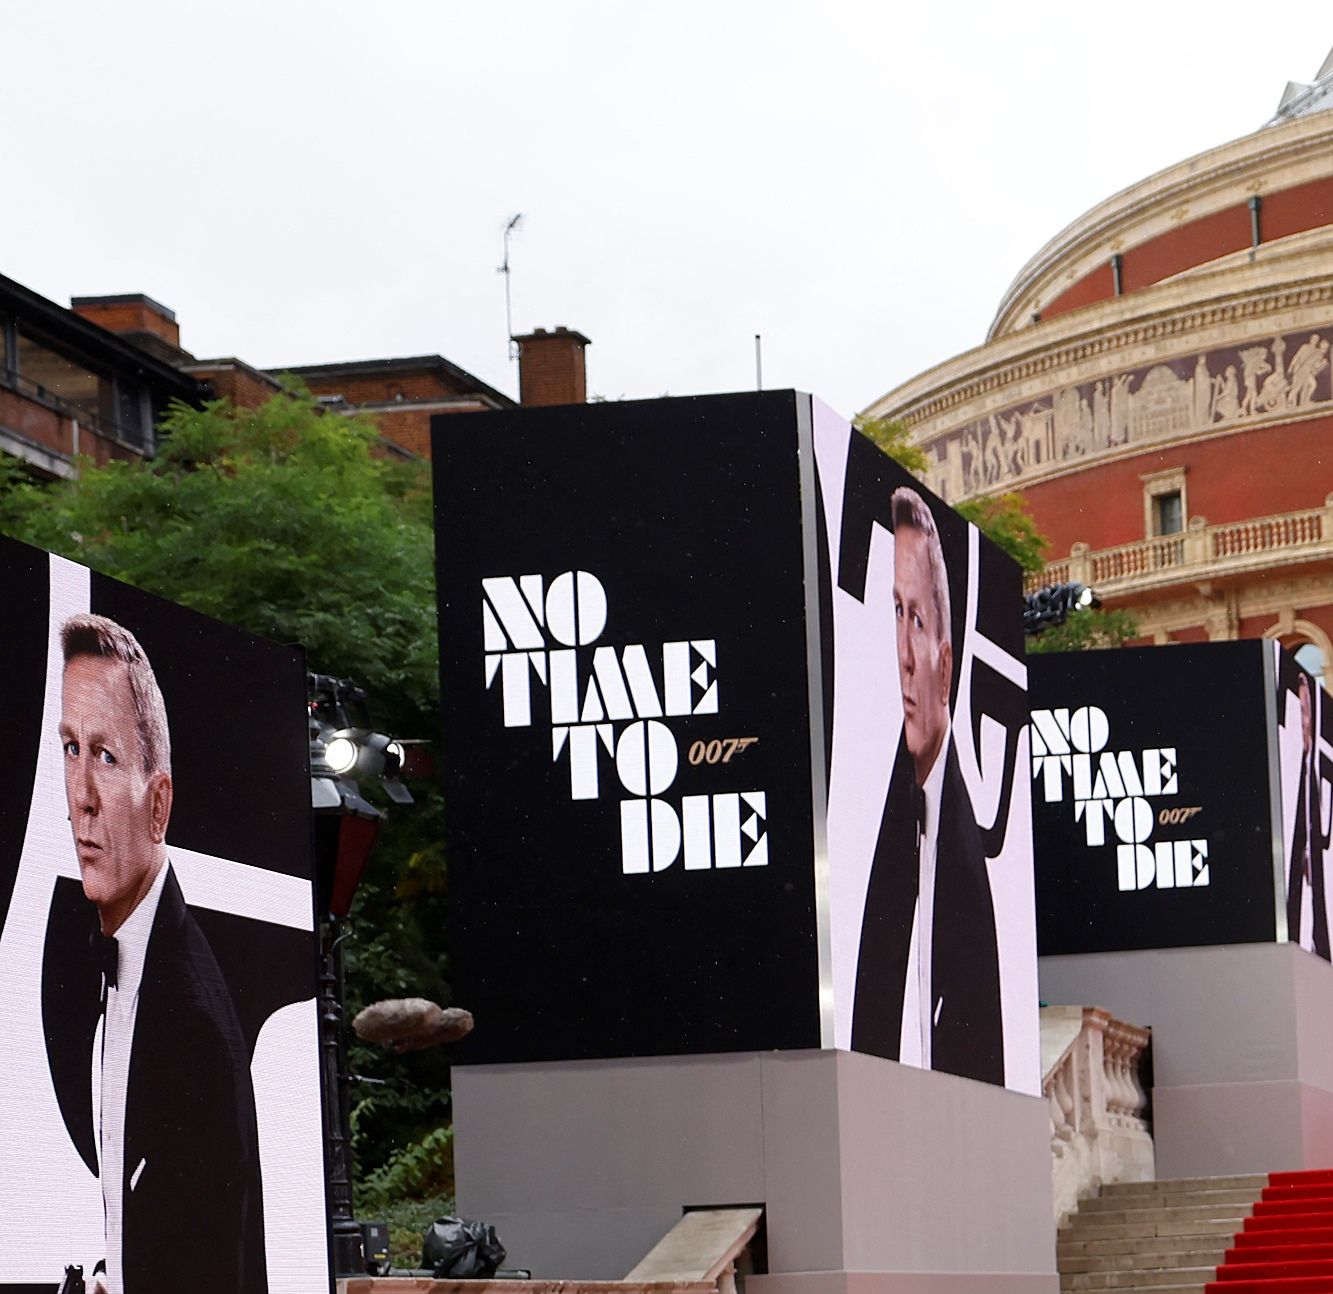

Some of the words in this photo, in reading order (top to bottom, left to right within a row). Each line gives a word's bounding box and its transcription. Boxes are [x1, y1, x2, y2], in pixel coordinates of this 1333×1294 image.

[482, 571, 607, 651] NO
[484, 640, 719, 727] TIME
[688, 737, 759, 766] 007
[1030, 706, 1110, 756] NO
[552, 720, 679, 800] TO
[1032, 747, 1178, 803] TIME
[621, 791, 768, 874] DIE
[1074, 796, 1154, 847] TO
[1158, 806, 1203, 825] 007
[1116, 839, 1210, 892] DIE
